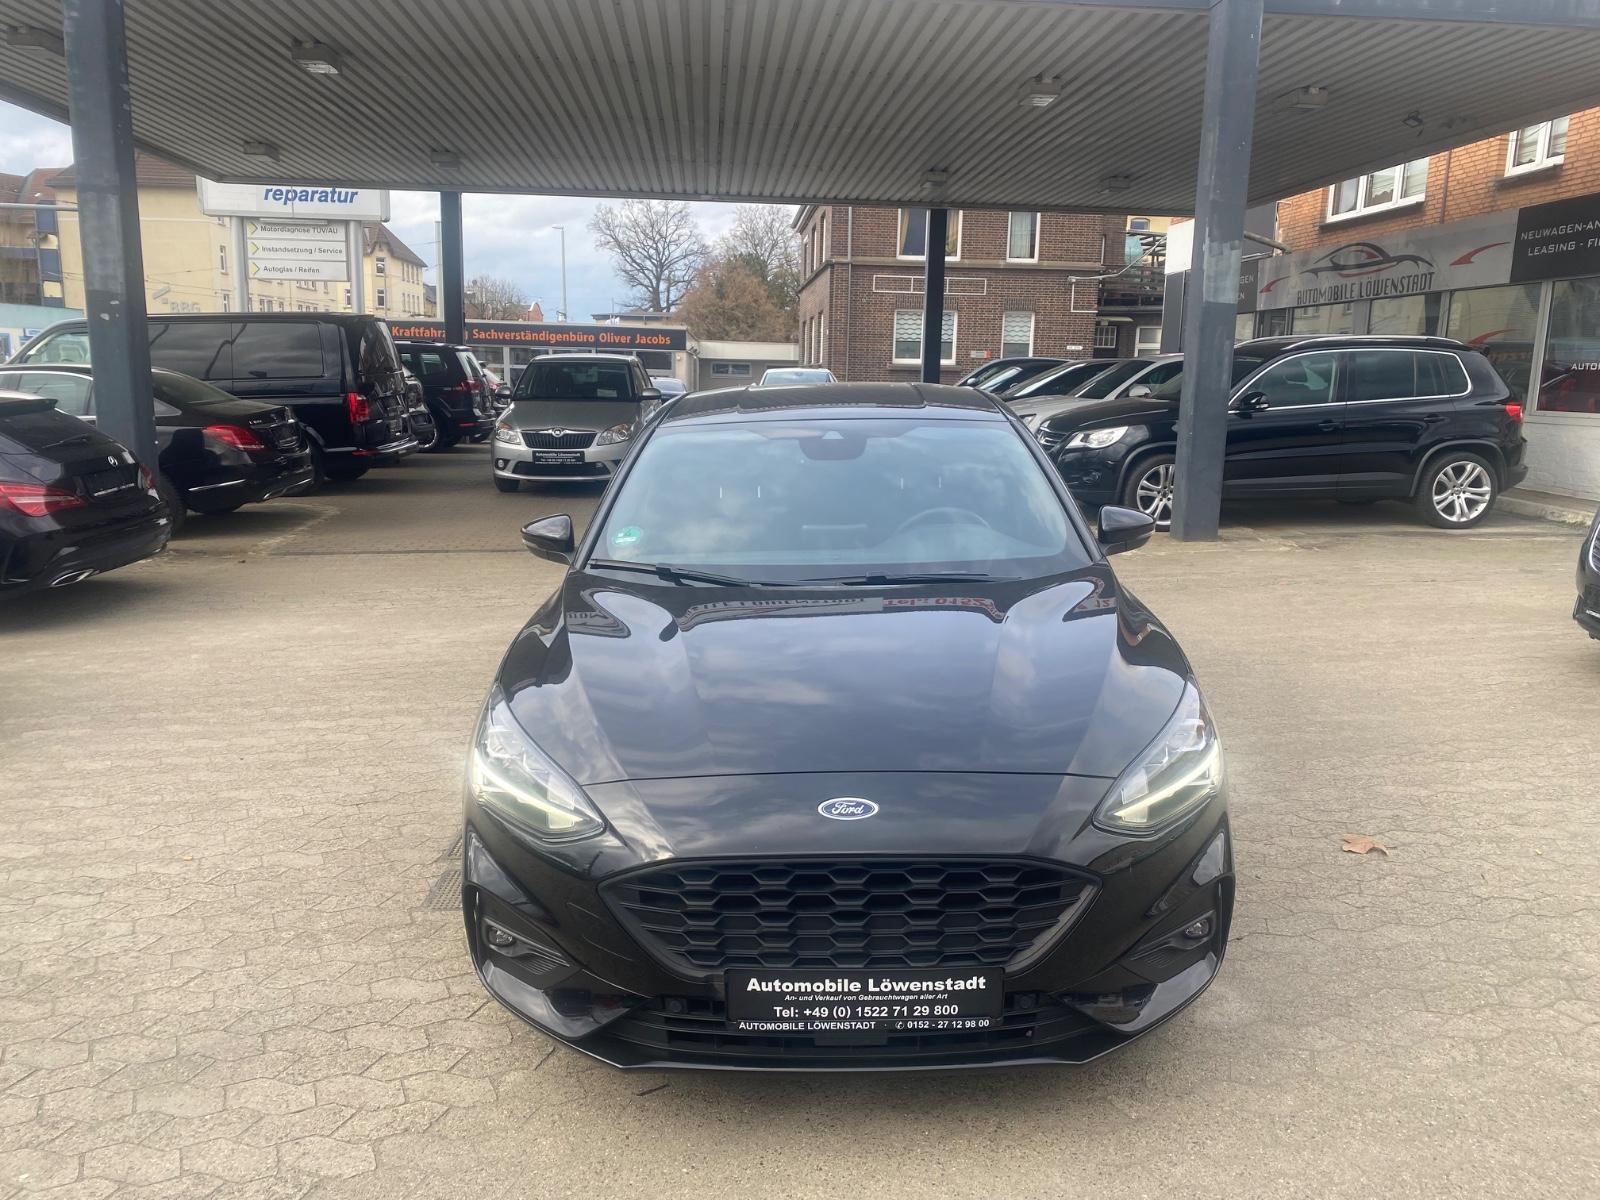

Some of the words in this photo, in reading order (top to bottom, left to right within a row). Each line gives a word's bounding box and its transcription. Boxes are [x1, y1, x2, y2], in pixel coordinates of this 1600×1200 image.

[263, 187, 359, 205] reparatur
[260, 225, 310, 234] Motordiagnose
[261, 245, 313, 255] Instandsetzung
[317, 246, 343, 255] Service
[1527, 241, 1576, 256] LEASING
[263, 265, 293, 274] Autoglas
[298, 266, 320, 274] Reifen
[1297, 282, 1355, 306] AUTOMOBILE
[1359, 271, 1435, 299] LÖWENSTADT
[472, 328, 595, 343] Sachverständigenbüro
[599, 332, 631, 344] Oliver
[635, 334, 671, 345] Jacobs
[1570, 362, 1600, 370] AUTO
[831, 801, 865, 815] Ford
[746, 977, 861, 992] Automobile
[868, 976, 986, 992] Löwenstadt
[858, 993, 918, 1001] Gebrauchtwagen
[773, 1006, 799, 1018] Tel:
[803, 1006, 829, 1017] +49
[832, 1005, 851, 1019] (0)
[855, 1005, 888, 1017] 1522
[892, 1005, 908, 1017] 71
[913, 1005, 930, 1016] 29
[933, 1004, 959, 1016] 800
[739, 1021, 805, 1031] AUTOMOBILE
[807, 1020, 876, 1031] LÖWENSTADT
[907, 1021, 929, 1029] 0152
[937, 1021, 949, 1029] 27
[951, 1021, 963, 1029] 12
[964, 1021, 977, 1029] 98
[978, 1019, 990, 1028] 00
